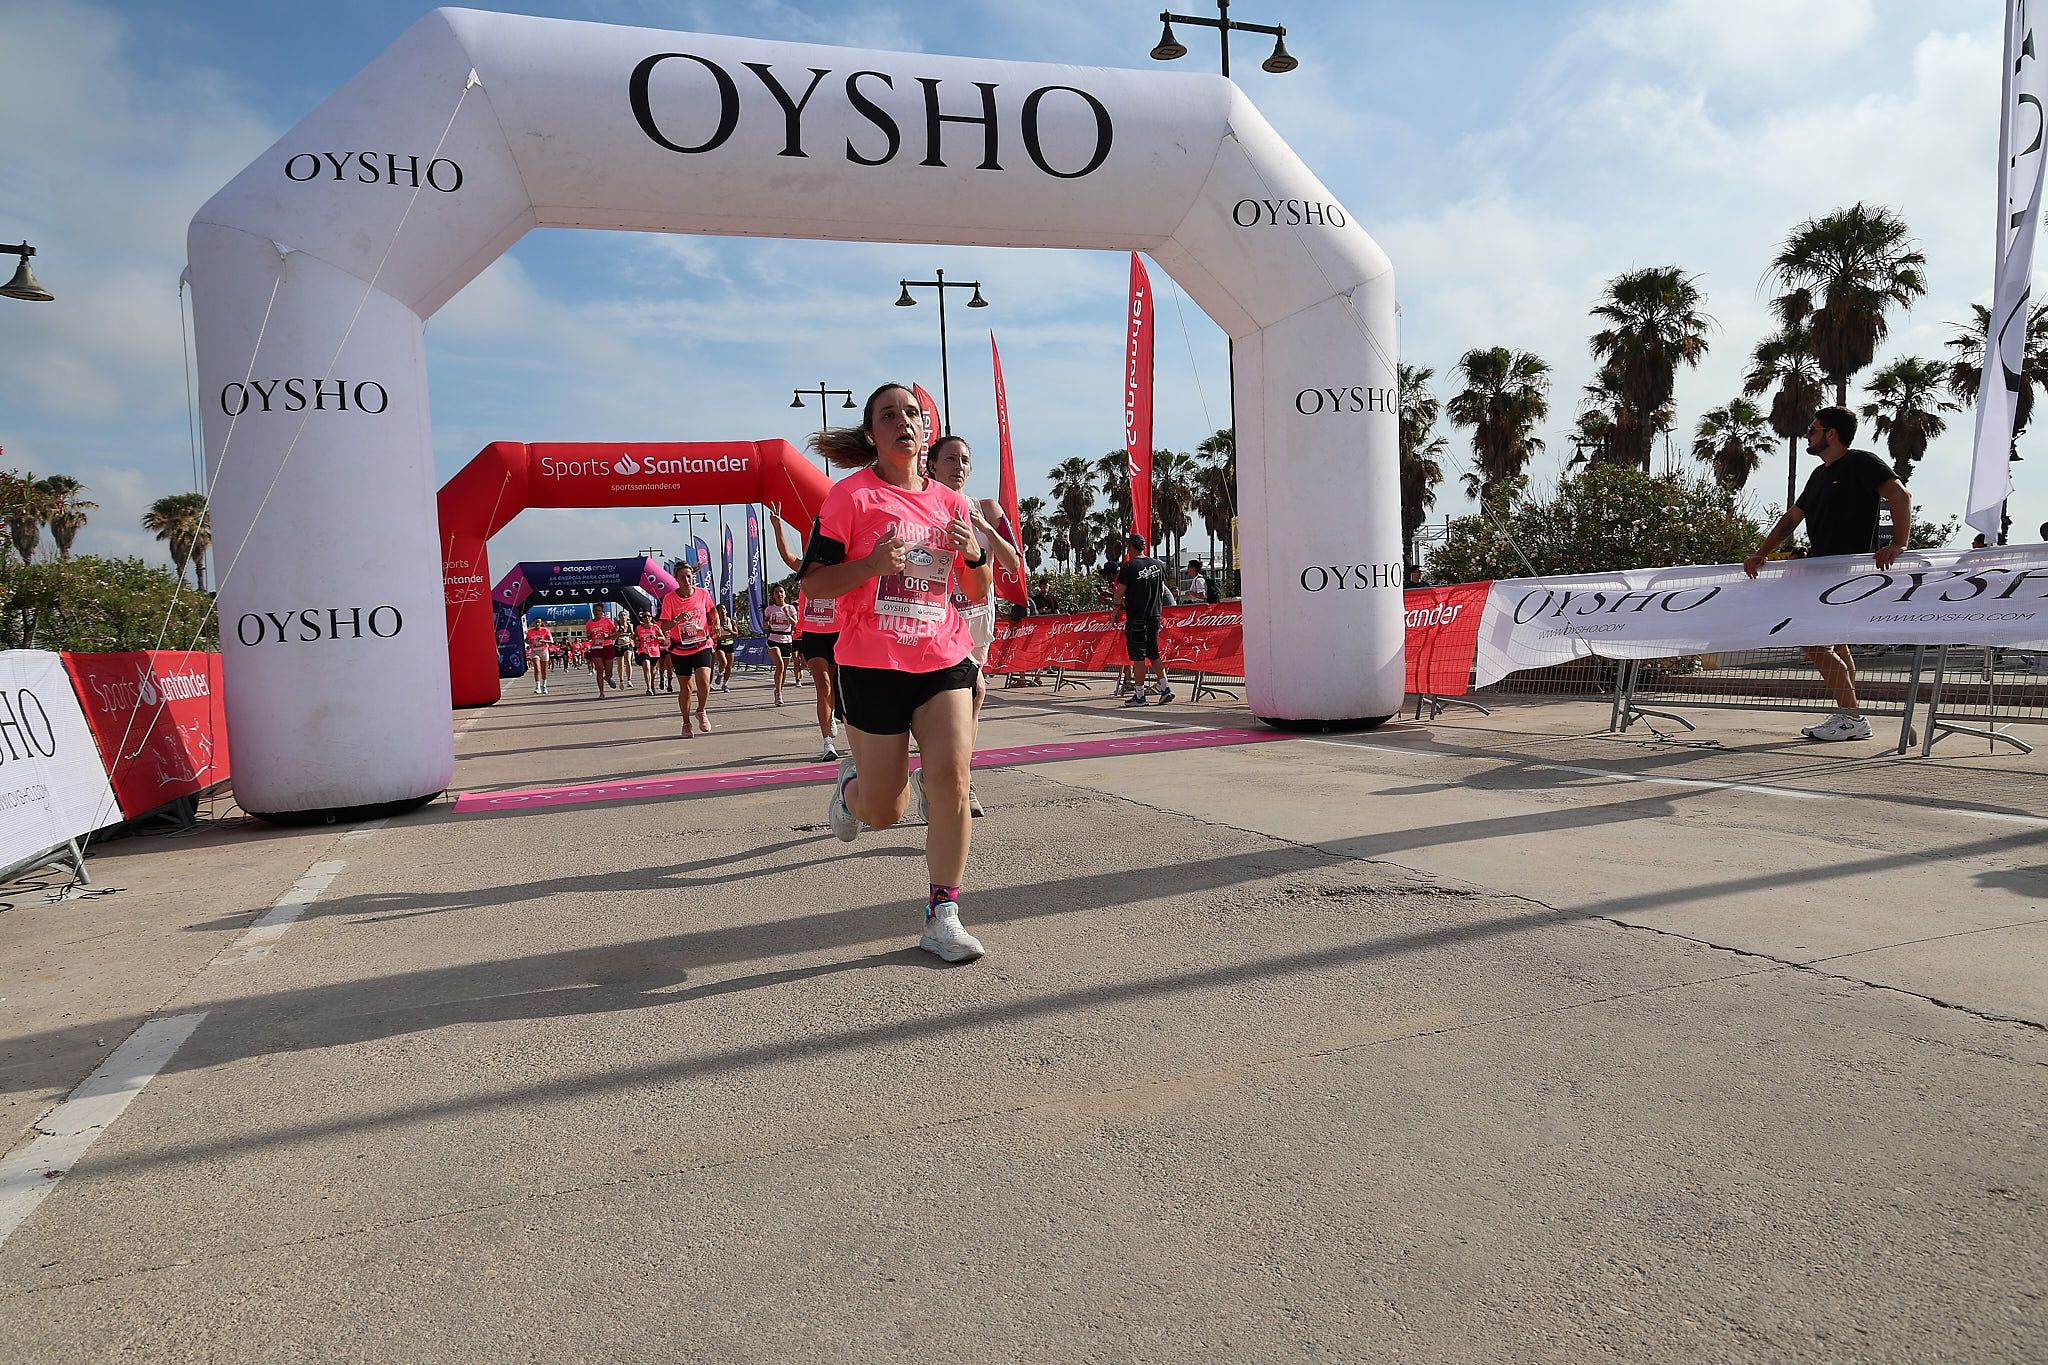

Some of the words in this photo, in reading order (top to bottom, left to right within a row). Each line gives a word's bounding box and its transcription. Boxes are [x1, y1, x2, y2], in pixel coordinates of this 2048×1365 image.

[629, 52, 1114, 179] OYSHO
[284, 151, 464, 193] OYSHO
[1232, 199, 1346, 228] OYSHO
[220, 378, 389, 417] OYSHO
[1295, 386, 1398, 416] OYSHO
[541, 456, 610, 481] Sports
[643, 455, 750, 475] Santander
[611, 481, 681, 492] sportssantander.es
[443, 559, 470, 570] ports
[562, 565, 592, 573] octopus
[1300, 562, 1402, 593] OYSHO
[444, 575, 484, 585] ntander
[538, 587, 609, 597] VOLVO
[904, 577, 929, 592] 016
[1819, 567, 2048, 606] OYSH
[883, 604, 910, 613] OYSHO
[1404, 602, 1463, 627] ander
[1514, 586, 1722, 624] OYSHO
[1870, 612, 2036, 624] WWW.OYSHO.COM
[237, 604, 403, 647] OYSHO
[897, 634, 919, 647] 2026
[89, 674, 141, 722] Sports
[150, 667, 211, 703] Santander
